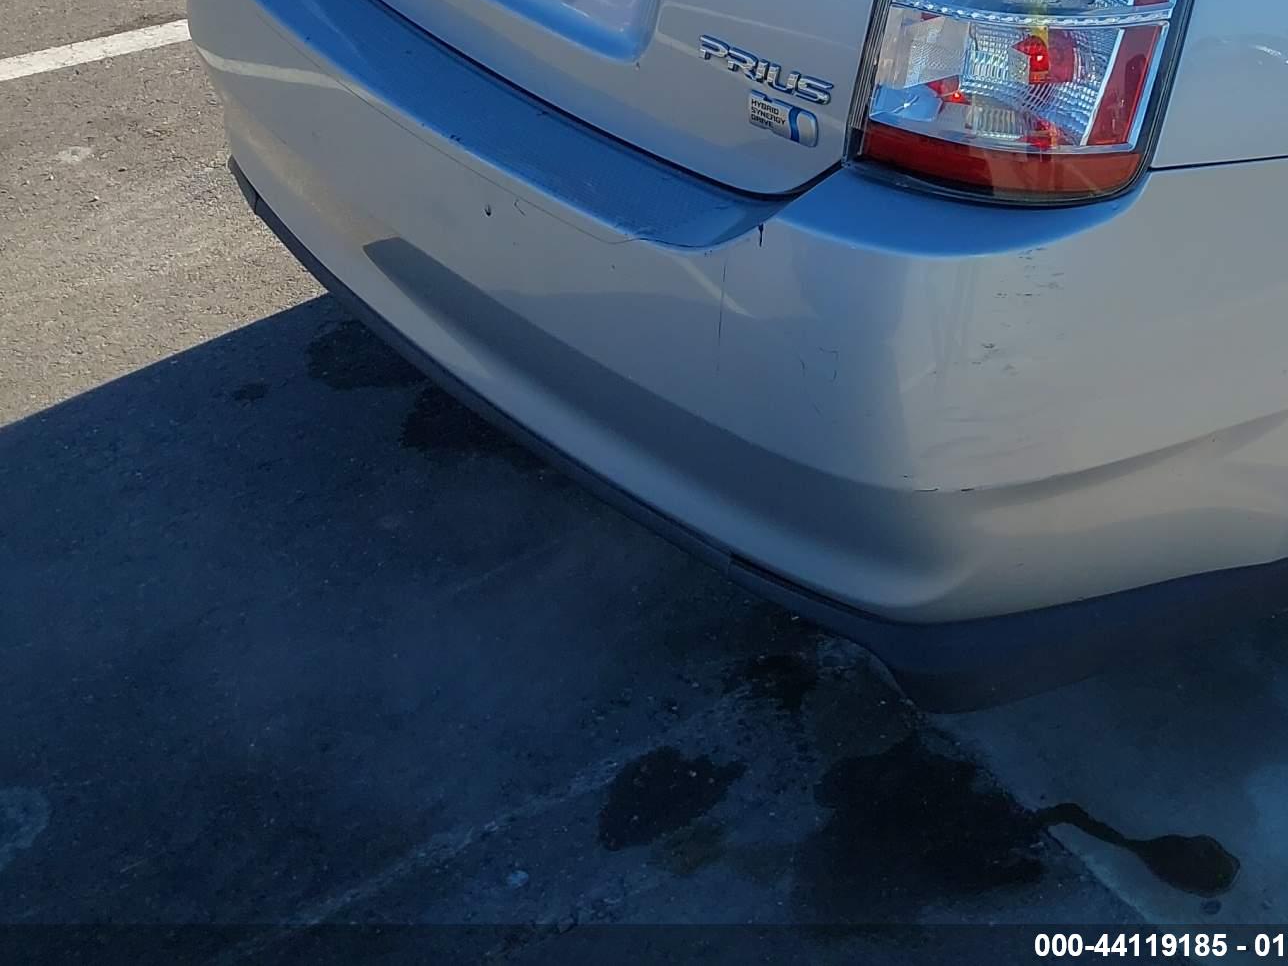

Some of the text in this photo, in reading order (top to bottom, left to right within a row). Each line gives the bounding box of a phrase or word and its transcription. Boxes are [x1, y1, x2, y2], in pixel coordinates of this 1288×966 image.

[699, 34, 834, 105] PRIUS
[751, 98, 779, 115] HYBRID
[751, 106, 786, 125] SYNERGY
[751, 114, 774, 128] DRIVE
